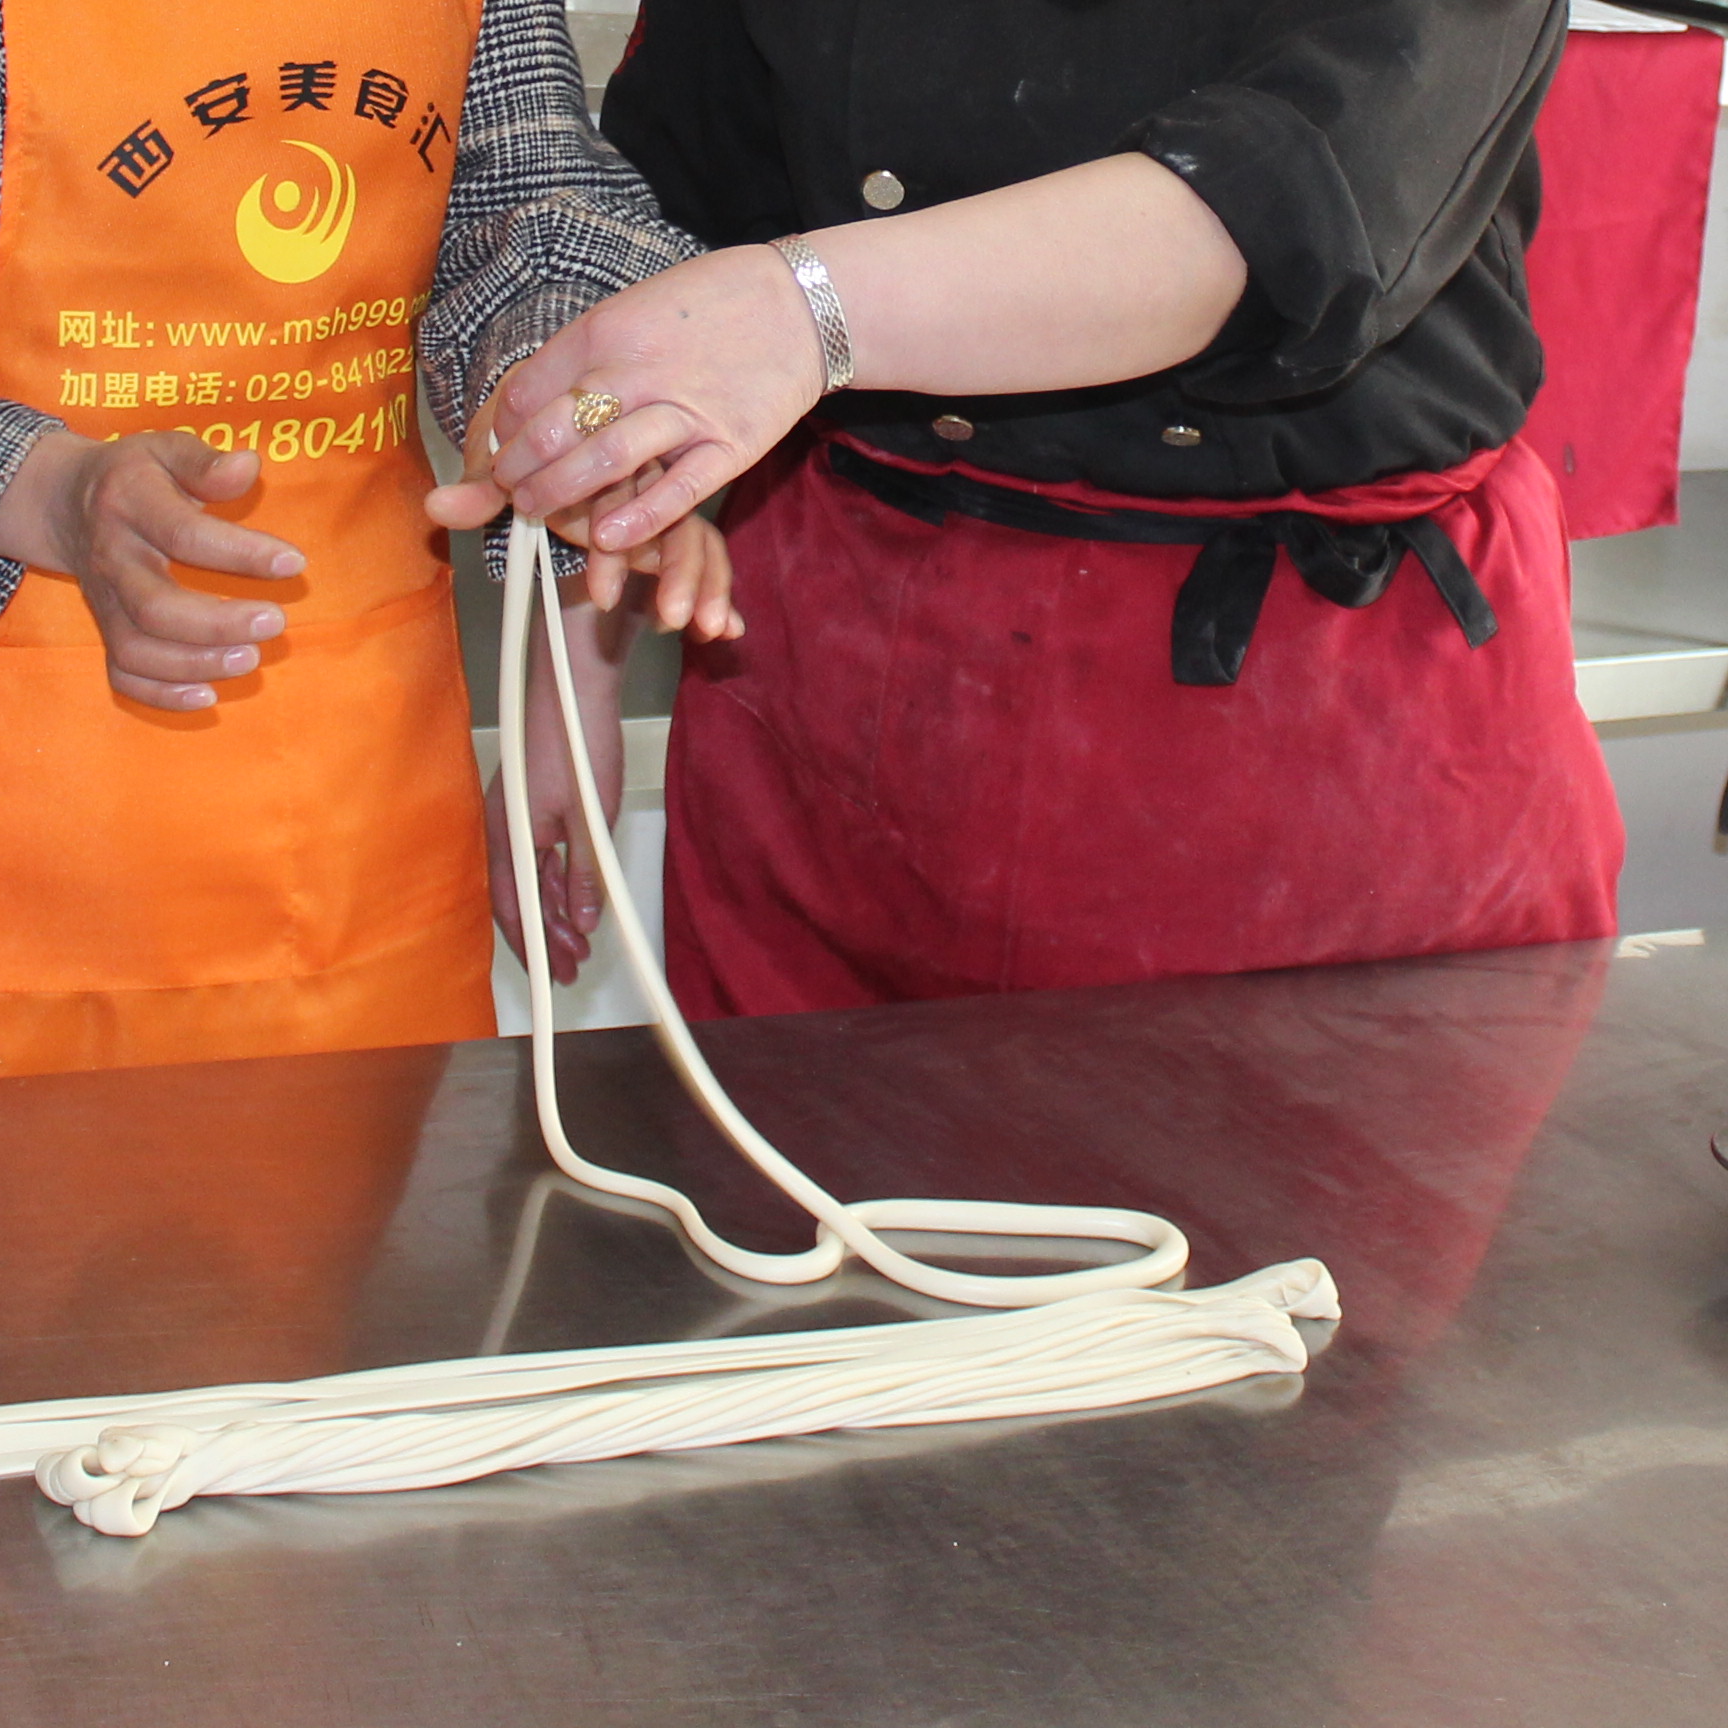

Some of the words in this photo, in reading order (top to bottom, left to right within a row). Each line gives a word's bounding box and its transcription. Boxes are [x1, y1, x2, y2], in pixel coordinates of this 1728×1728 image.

[97, 60, 452, 199] 西安美食汇
